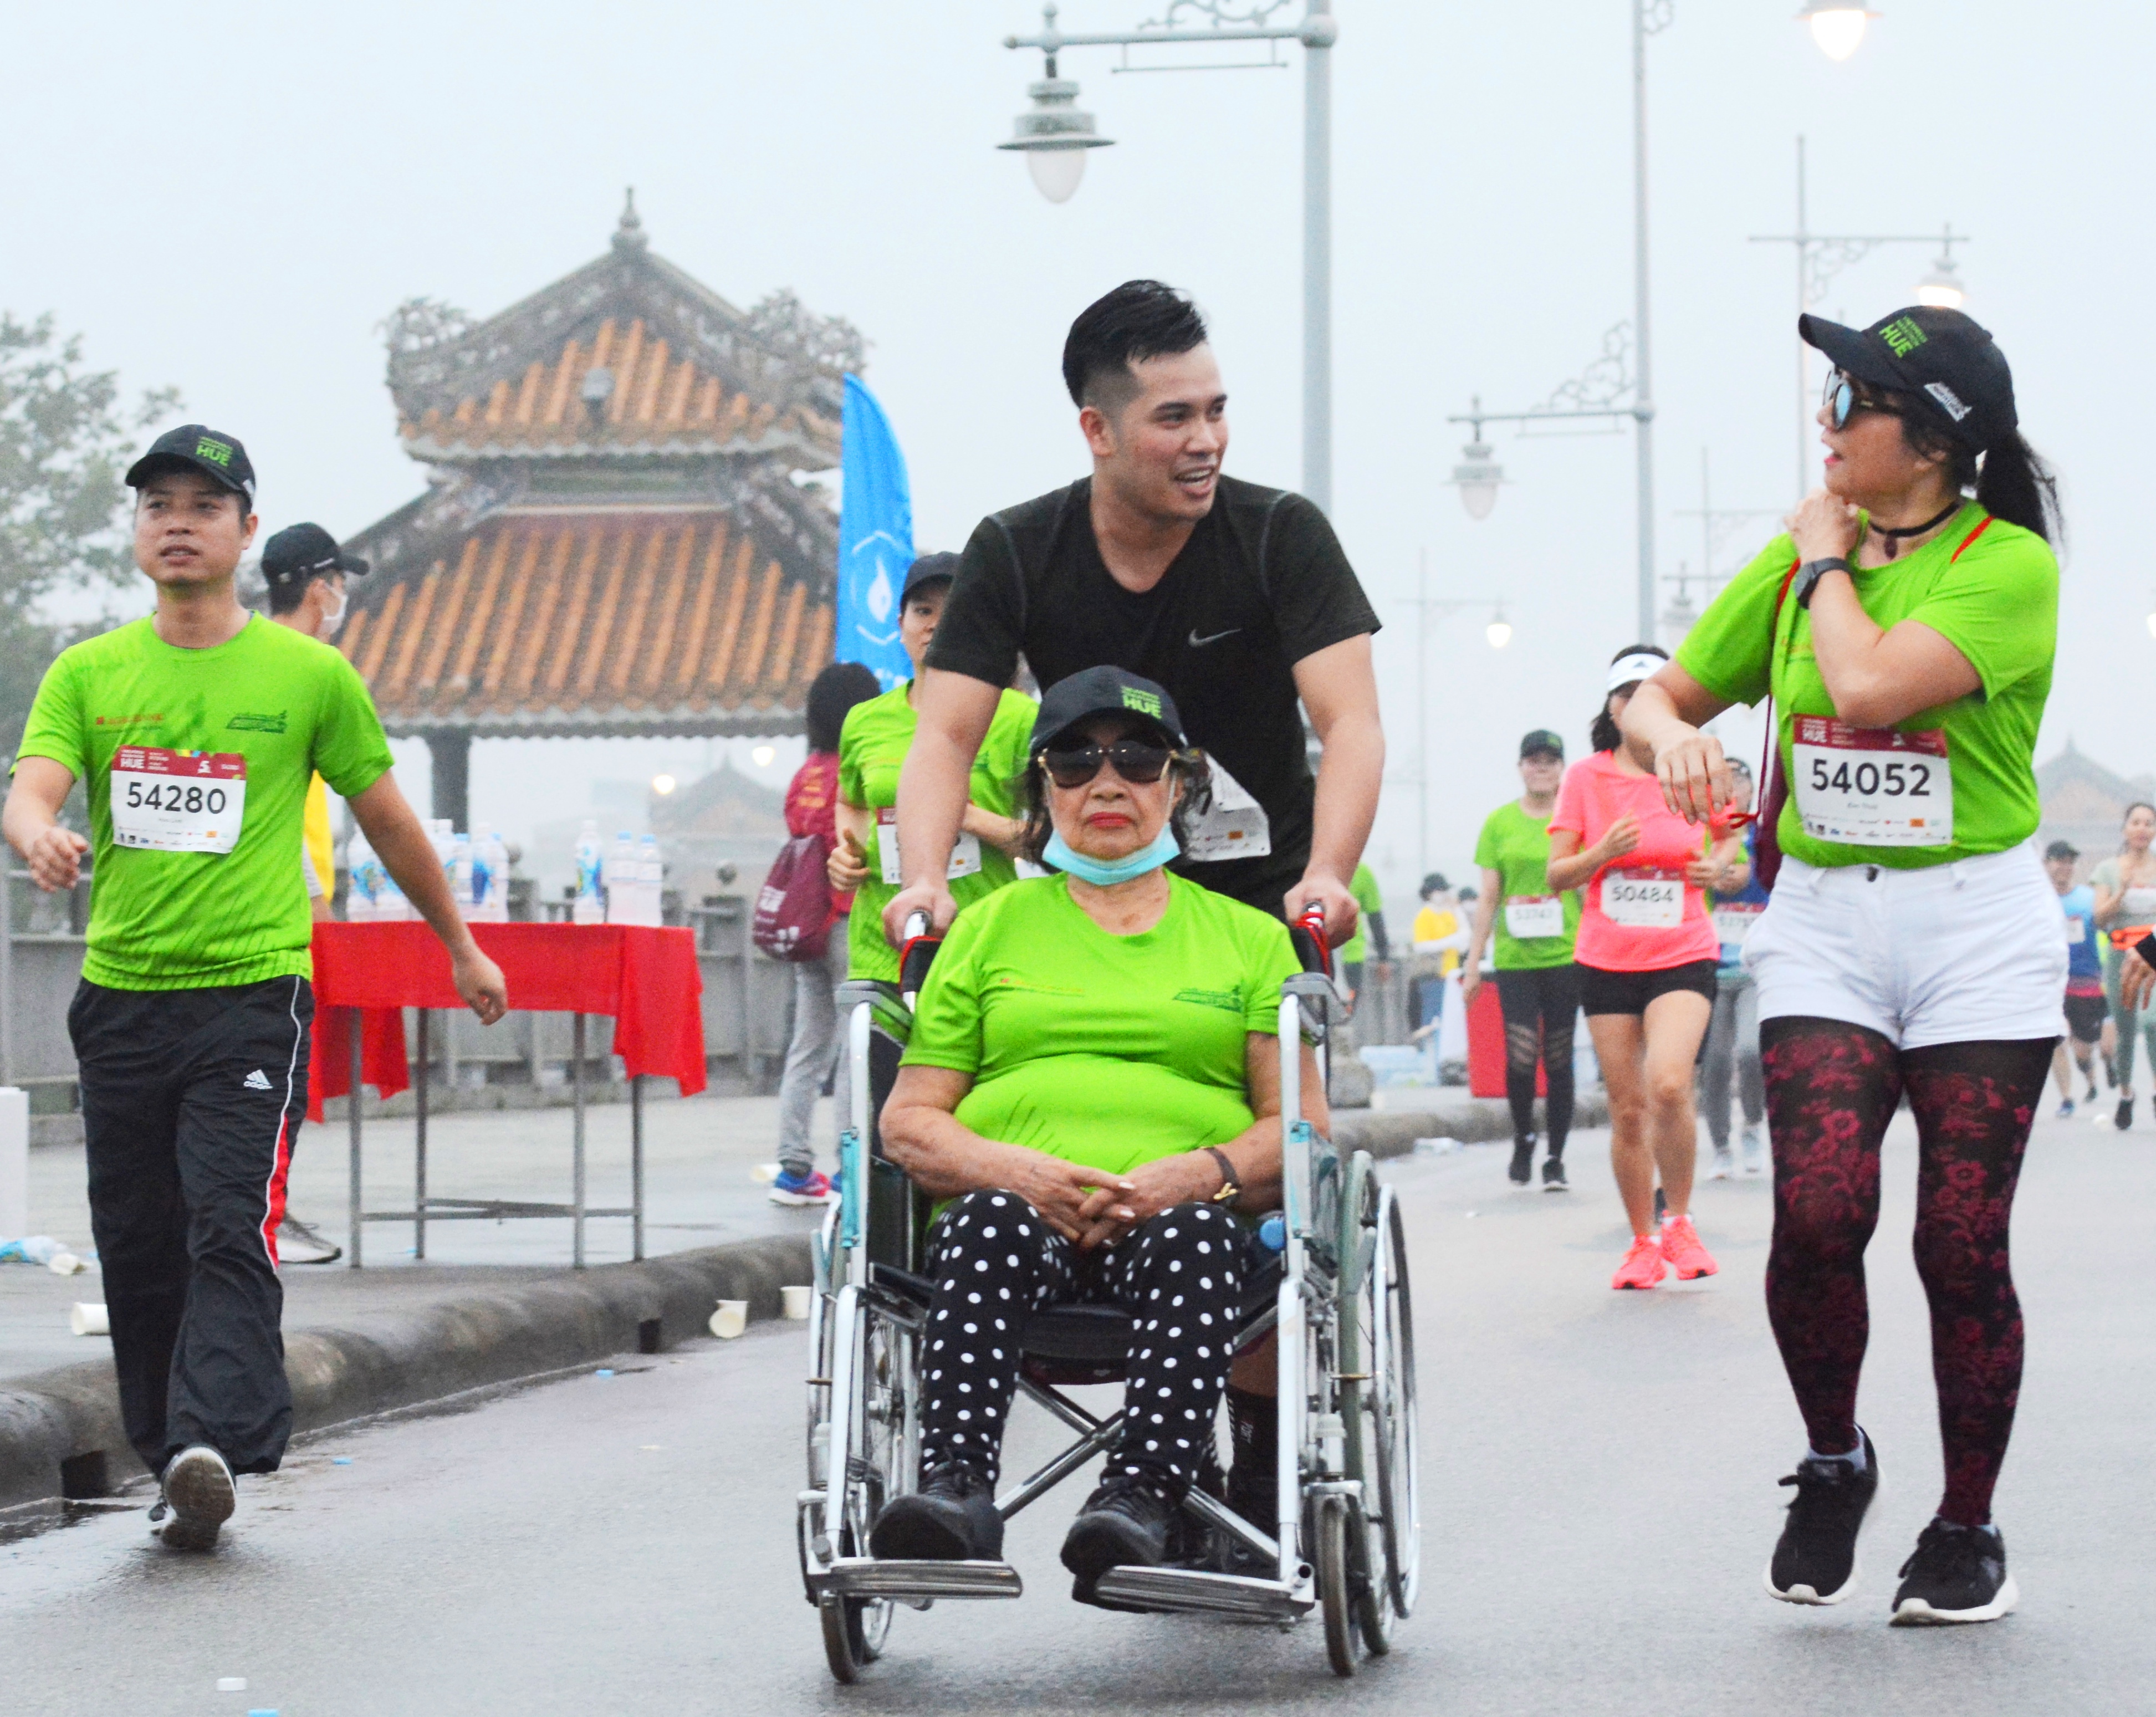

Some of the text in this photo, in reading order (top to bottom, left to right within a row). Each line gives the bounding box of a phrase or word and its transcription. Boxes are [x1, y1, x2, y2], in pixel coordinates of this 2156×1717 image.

[1878, 323, 1913, 358] HUE
[196, 444, 231, 467] HUE
[1123, 695, 1162, 719] HUE
[120, 757, 145, 769] HUE
[1811, 758, 1930, 796] 54052
[127, 781, 226, 814] 54280
[1612, 885, 1674, 902] 50484
